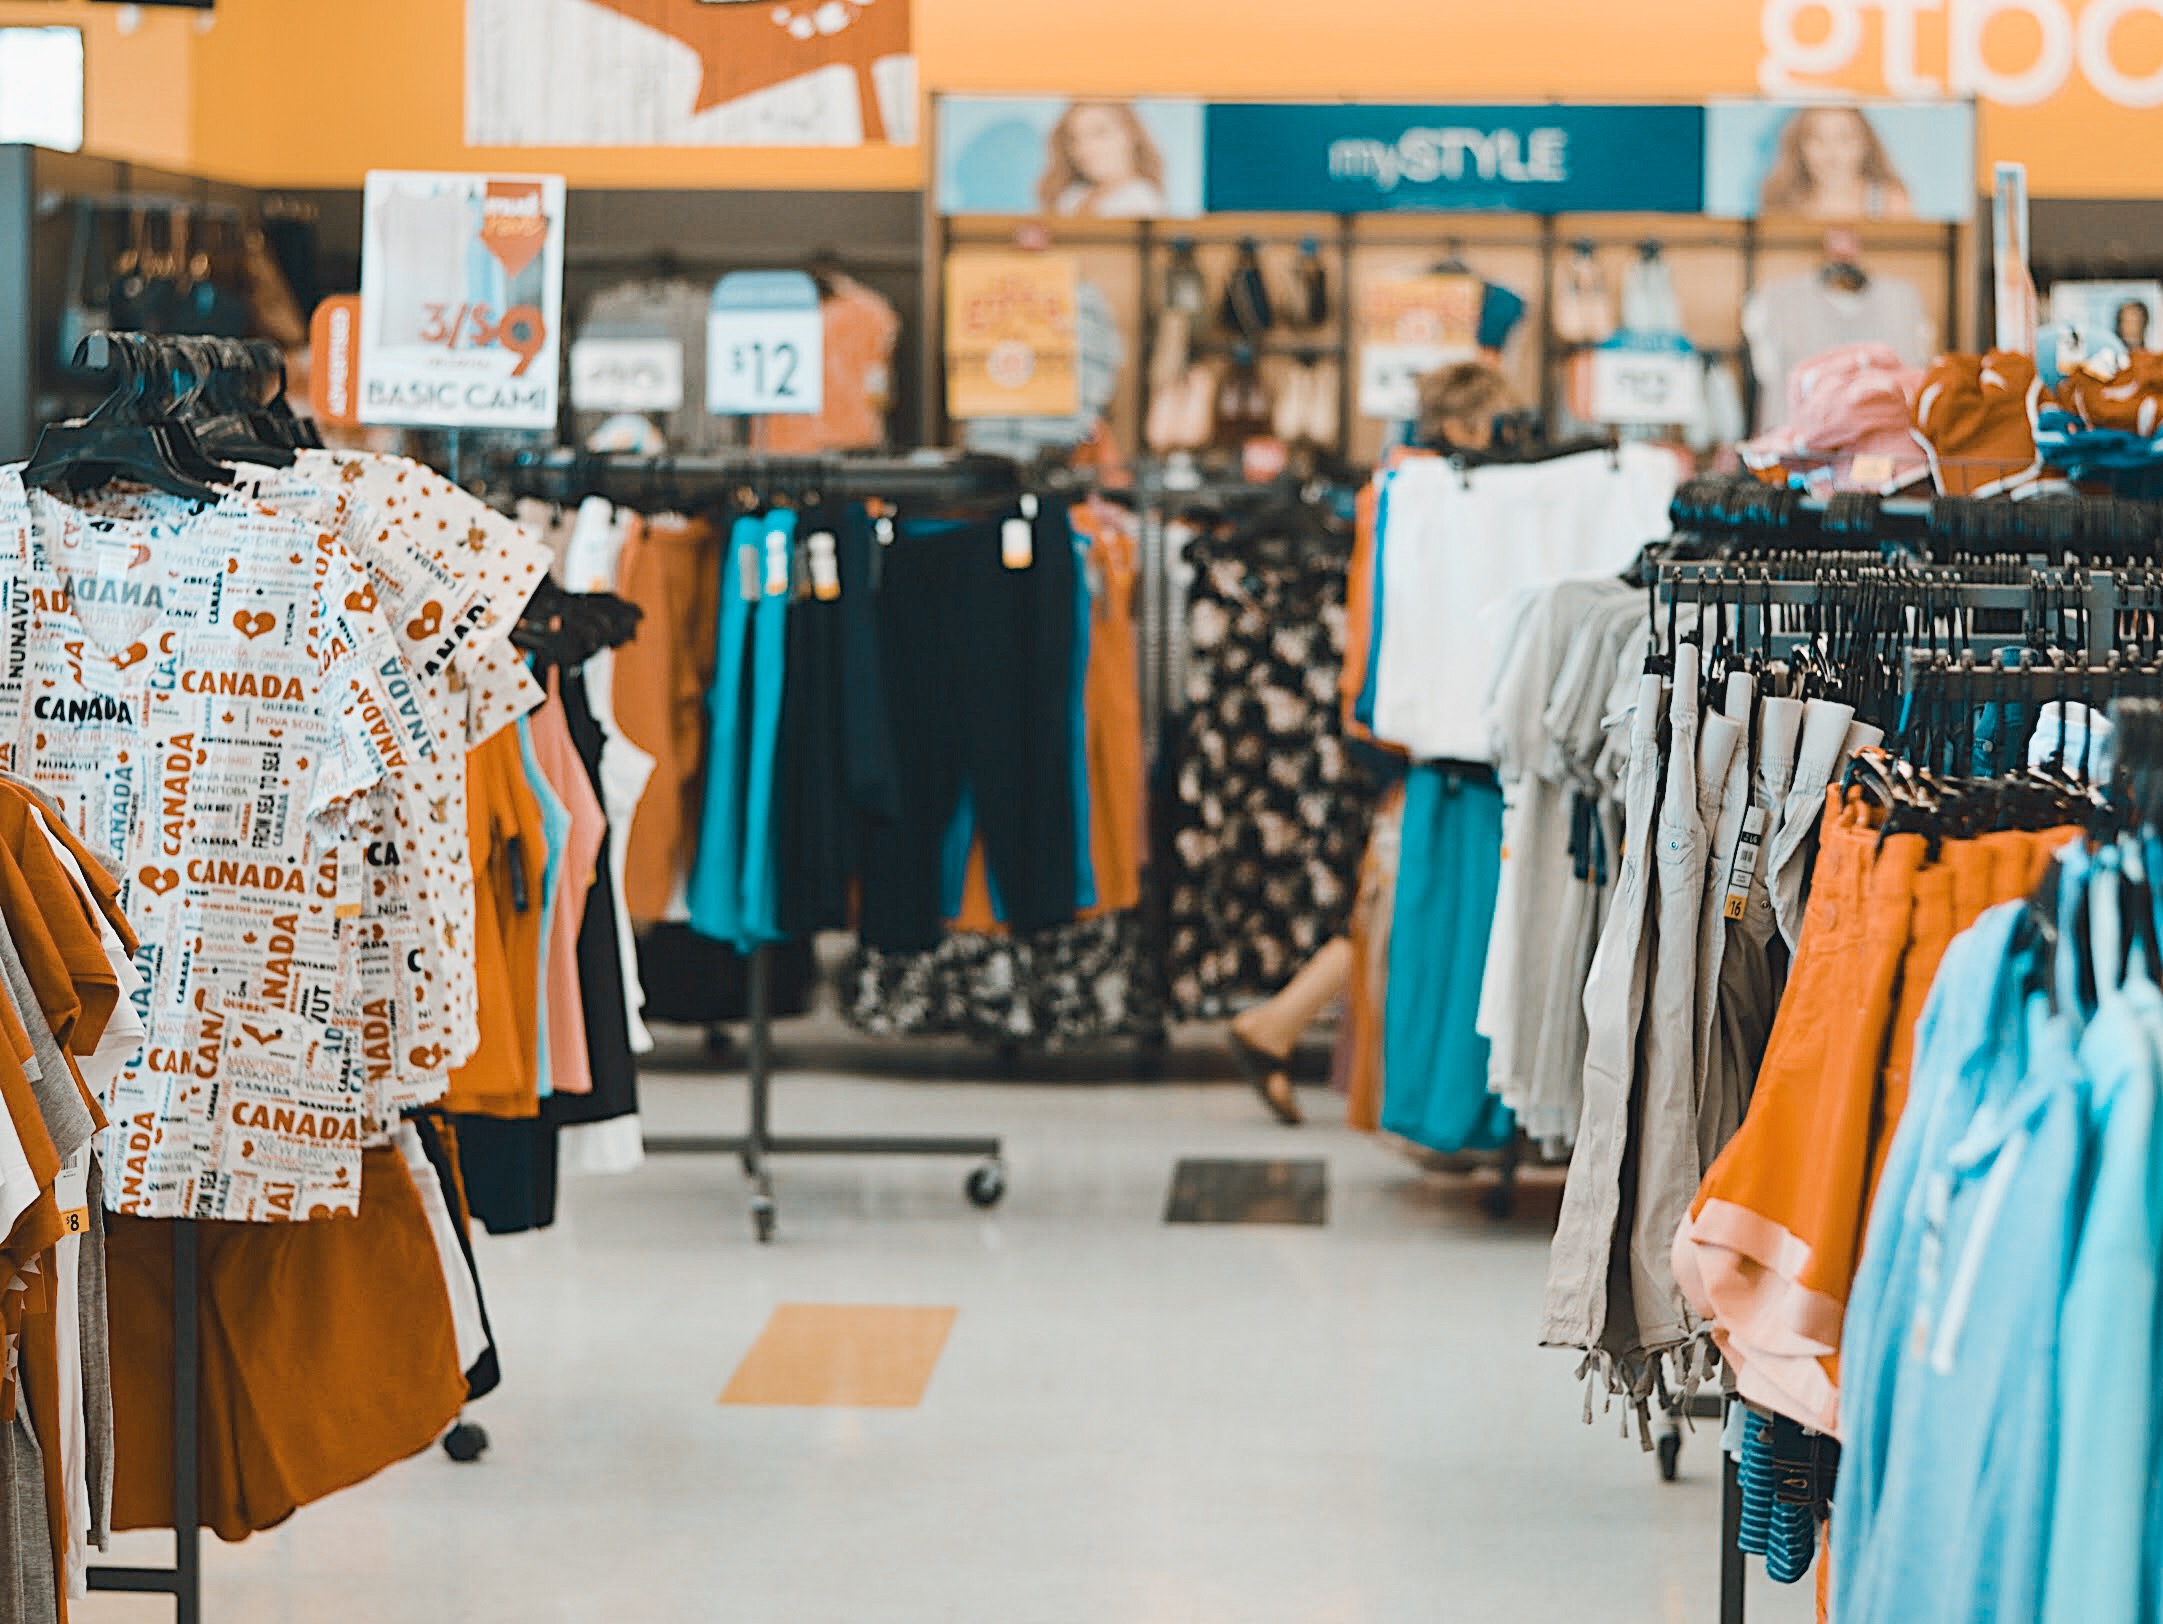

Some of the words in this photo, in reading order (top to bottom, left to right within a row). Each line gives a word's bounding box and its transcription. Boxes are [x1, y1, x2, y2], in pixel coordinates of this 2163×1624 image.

[732, 342, 798, 396] $12
[368, 379, 457, 409] BASIC
[465, 383, 549, 411] CAMI
[32, 588, 76, 616] AD
[9, 575, 30, 678] NUNAVUT
[182, 670, 304, 701] CANADA
[35, 697, 132, 725] CANADA
[256, 716, 288, 726] NOVA
[262, 702, 309, 714] QUEBEC
[163, 733, 194, 856] CANADA
[192, 785, 248, 797] MANITOBA
[257, 794, 275, 815] SEA
[251, 818, 273, 849] FROM
[367, 842, 400, 866] CA
[187, 859, 306, 895] CANADA
[293, 961, 337, 970] ONTARIO
[195, 1007, 225, 1079] CAN
[236, 1081, 291, 1097] CANADA
[232, 1102, 358, 1140] CANADA
[66, 1213, 80, 1232] $8
